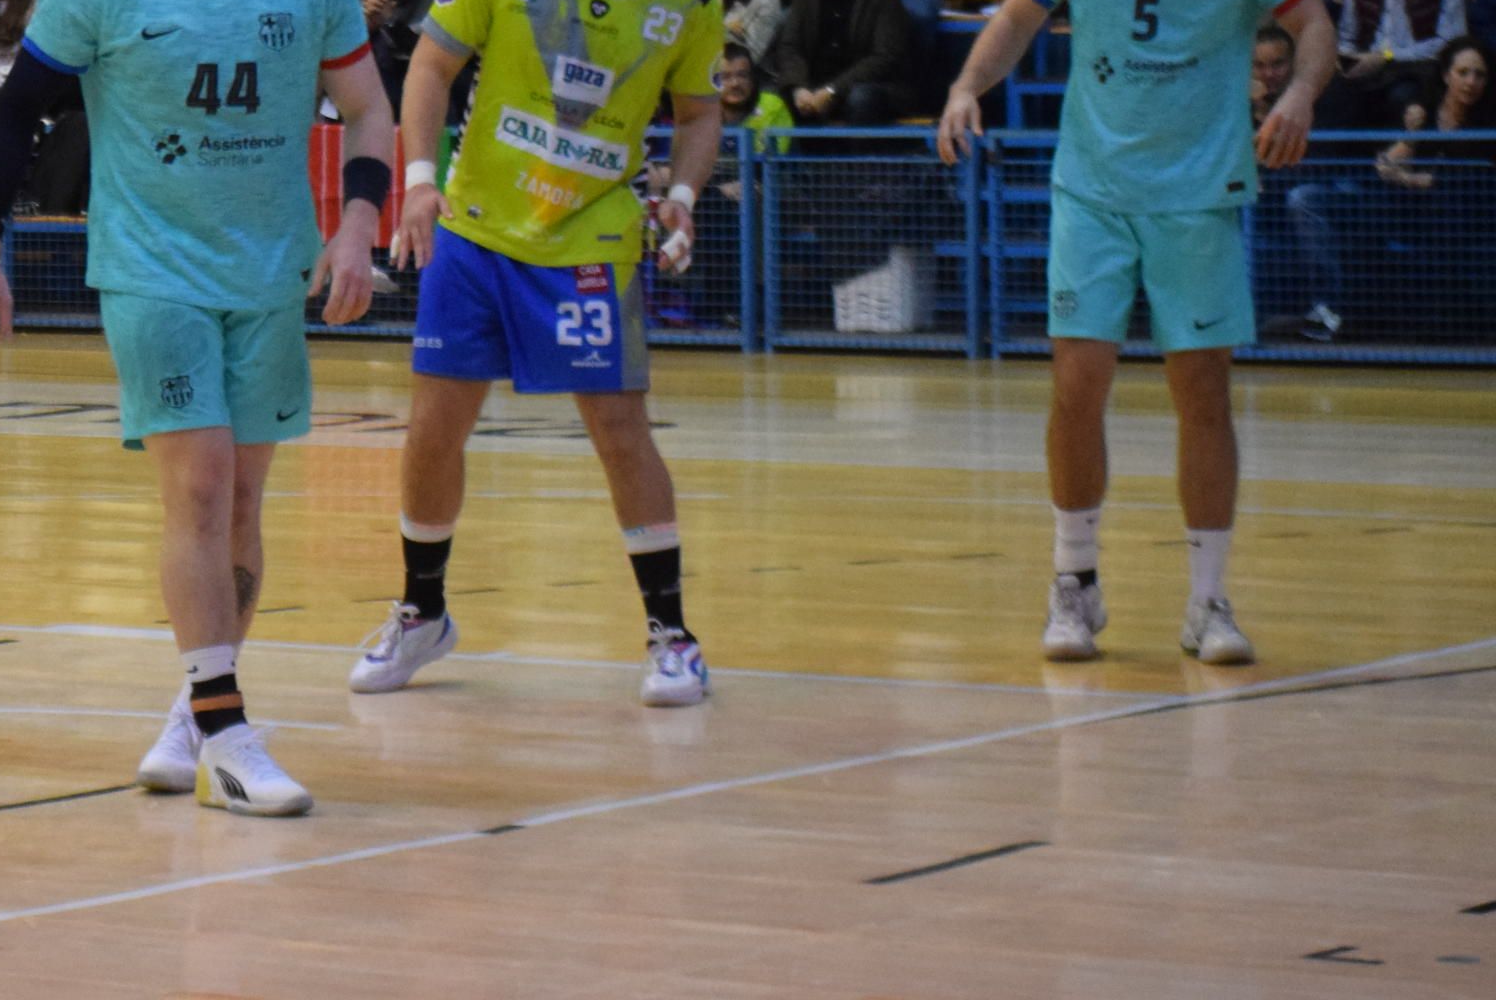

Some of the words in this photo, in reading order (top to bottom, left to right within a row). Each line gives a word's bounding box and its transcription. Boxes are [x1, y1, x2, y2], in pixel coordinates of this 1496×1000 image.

[642, 4, 684, 46] 23
[186, 62, 261, 115] 44
[562, 62, 606, 88] gaza
[502, 116, 548, 150] CAJA
[555, 300, 613, 347] 23
